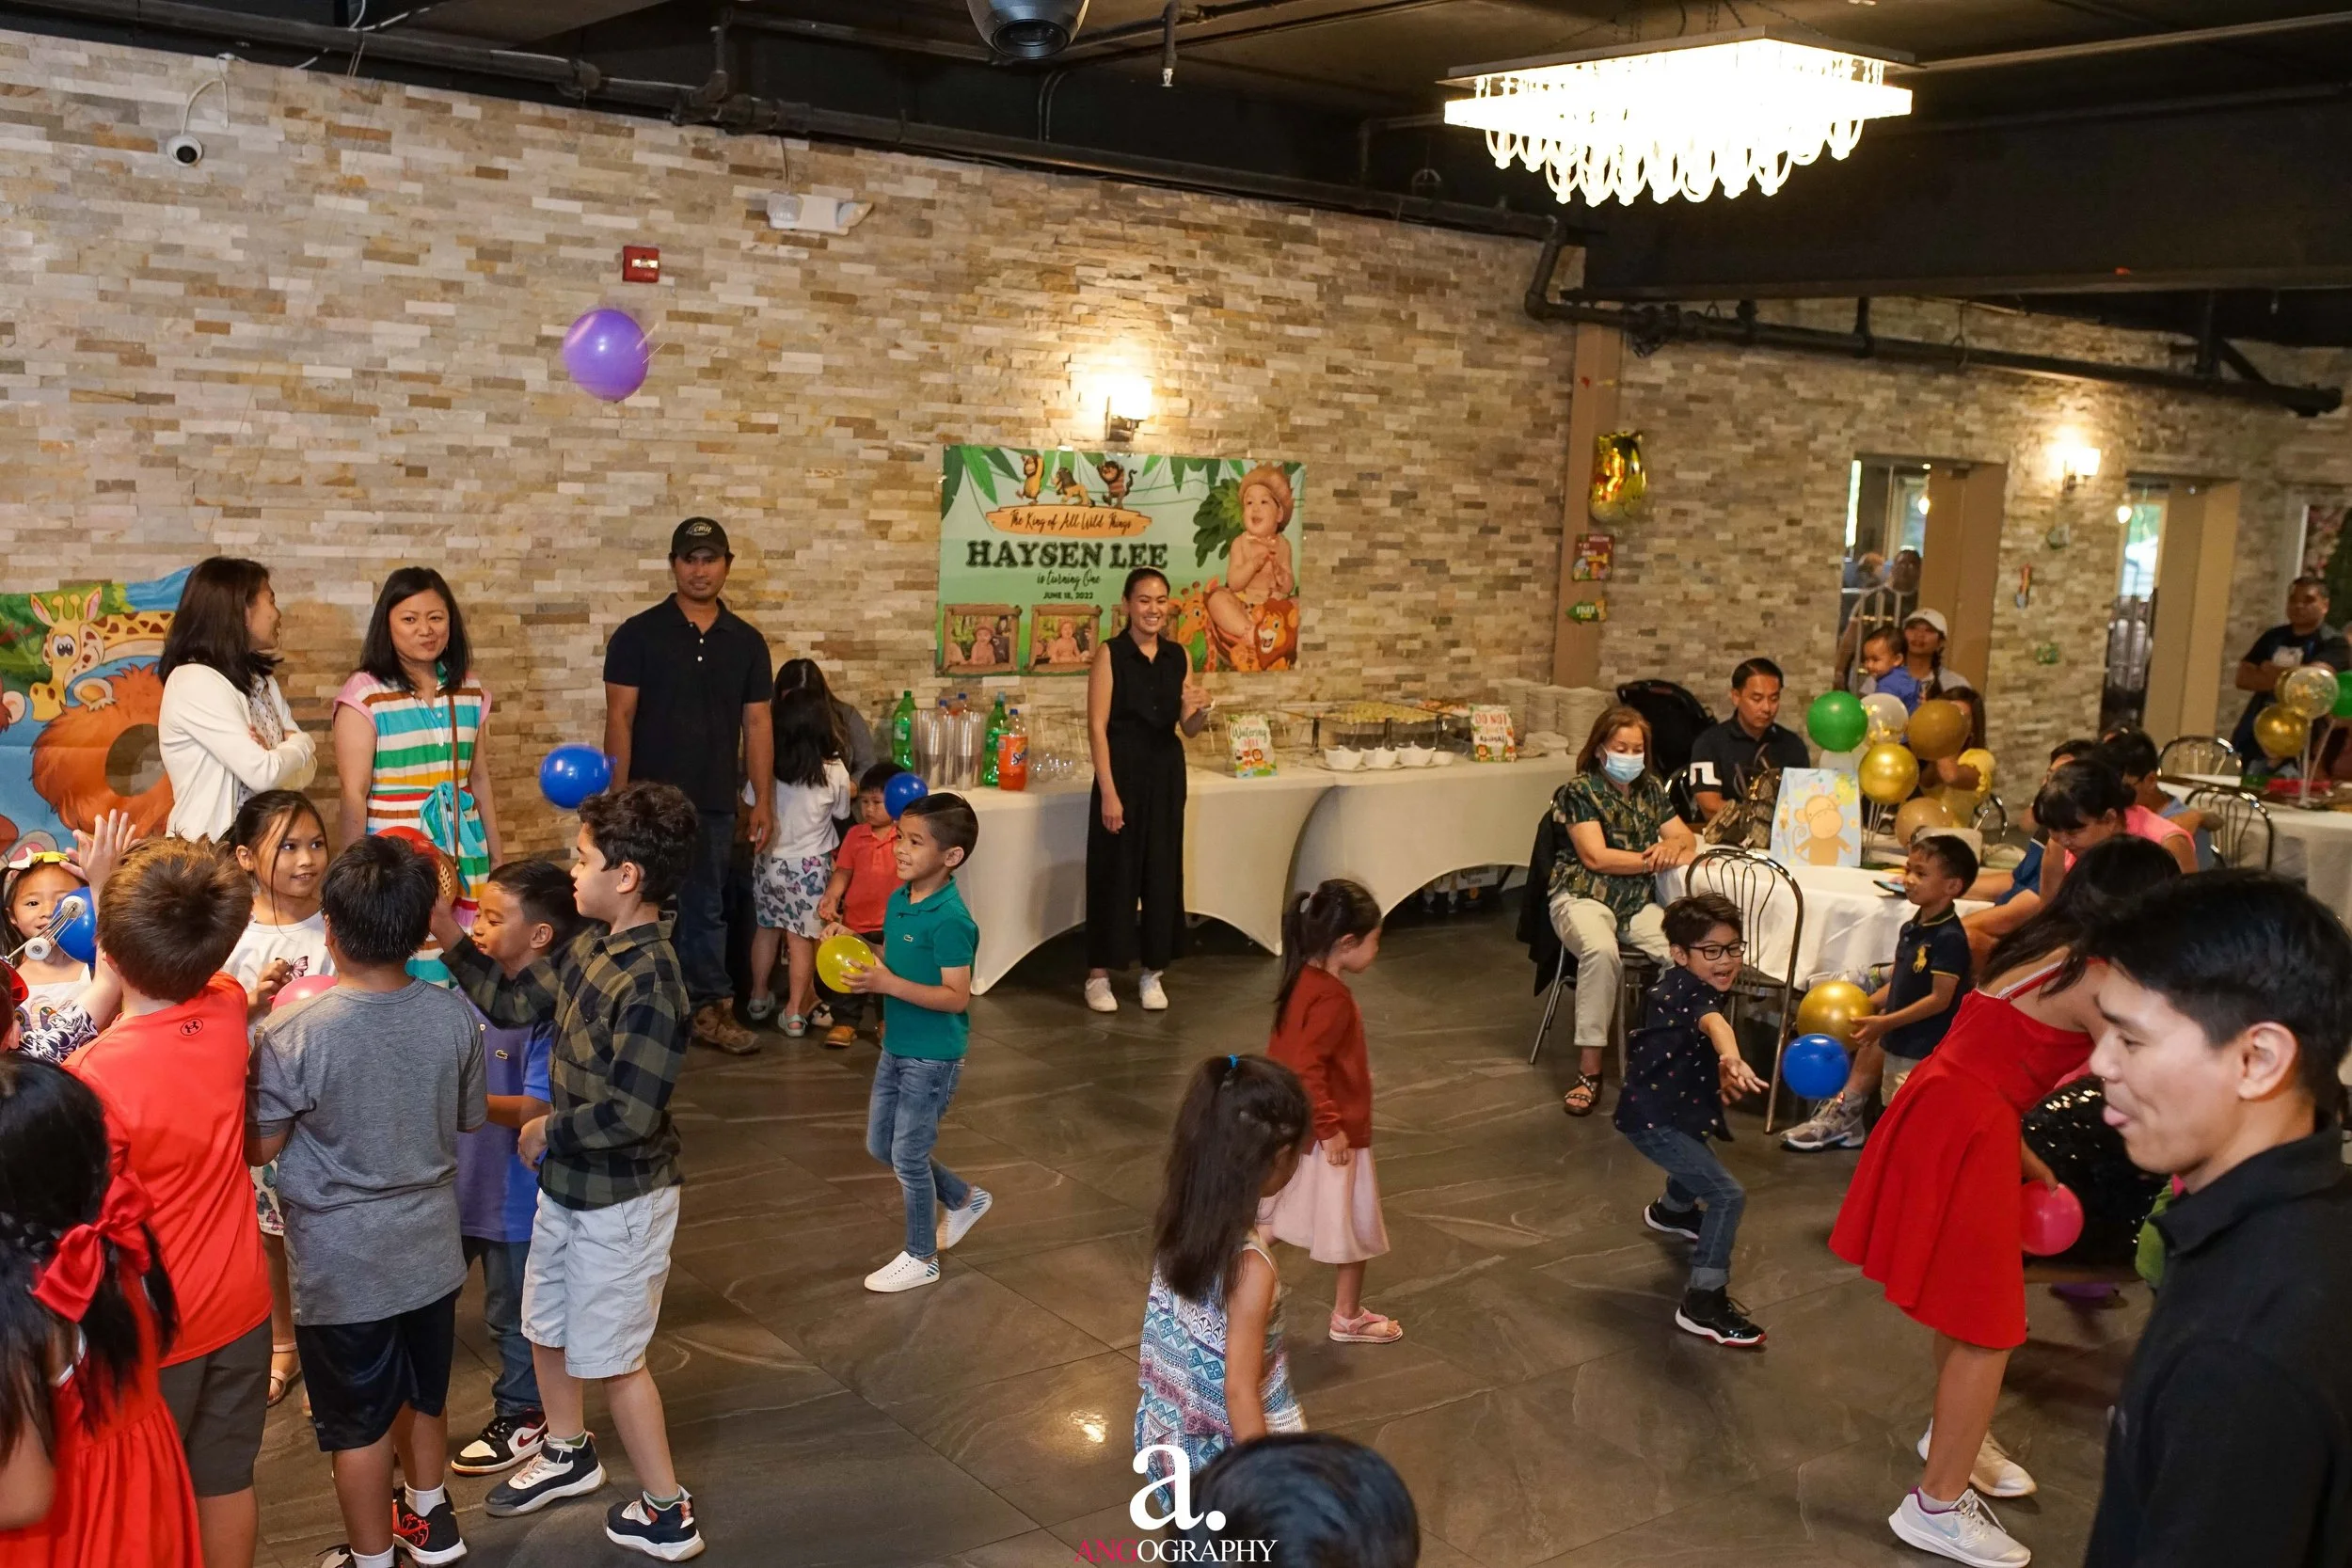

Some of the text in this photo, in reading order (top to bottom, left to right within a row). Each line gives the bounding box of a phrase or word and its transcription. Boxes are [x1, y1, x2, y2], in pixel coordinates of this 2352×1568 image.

[1010, 509, 1132, 535] The King of All Wild Things
[966, 540, 1168, 569] HAYSEN LEE
[1037, 568, 1101, 592] is turning One
